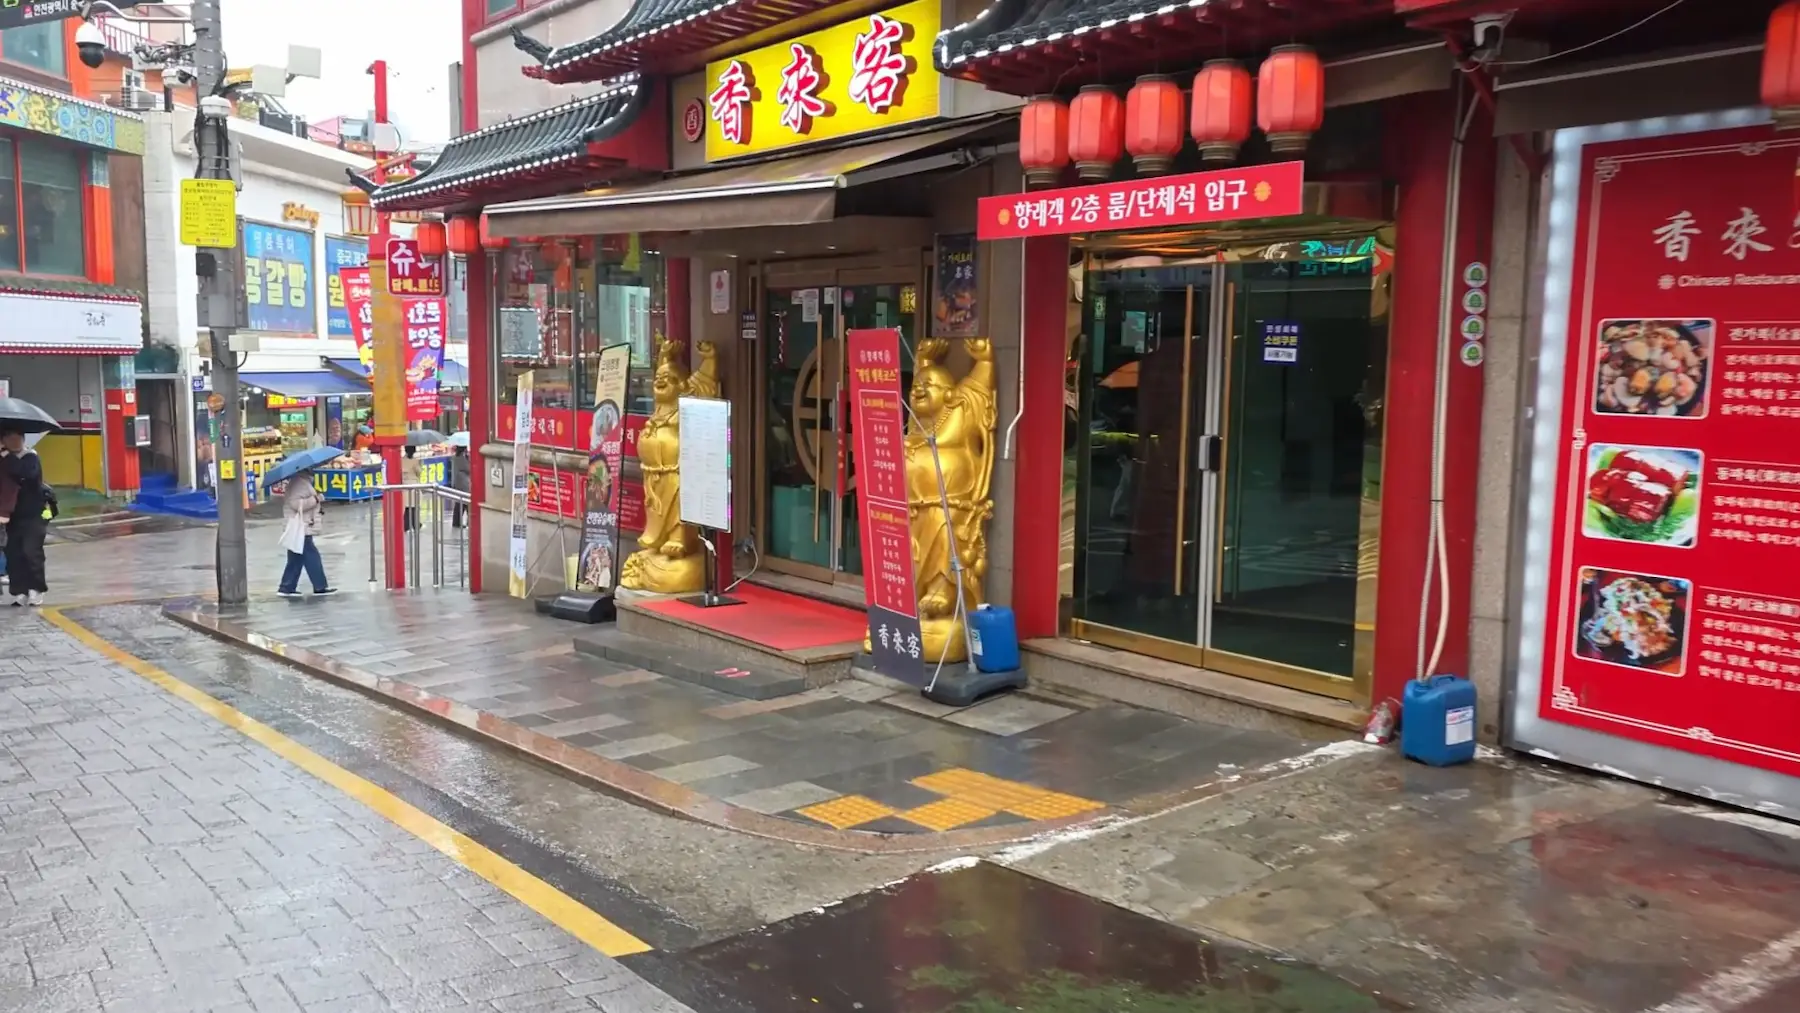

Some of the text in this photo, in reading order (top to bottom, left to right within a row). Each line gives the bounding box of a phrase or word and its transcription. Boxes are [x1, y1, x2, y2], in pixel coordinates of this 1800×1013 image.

[710, 15, 906, 143] 香來客
[1014, 179, 1247, 230] 향래객 2층 룸/단체석 입구
[1652, 206, 1800, 262] 香來
[1678, 275, 1732, 287] Chinese
[1264, 335, 1298, 346] 소비쿠폰
[878, 624, 920, 659] 香來客
